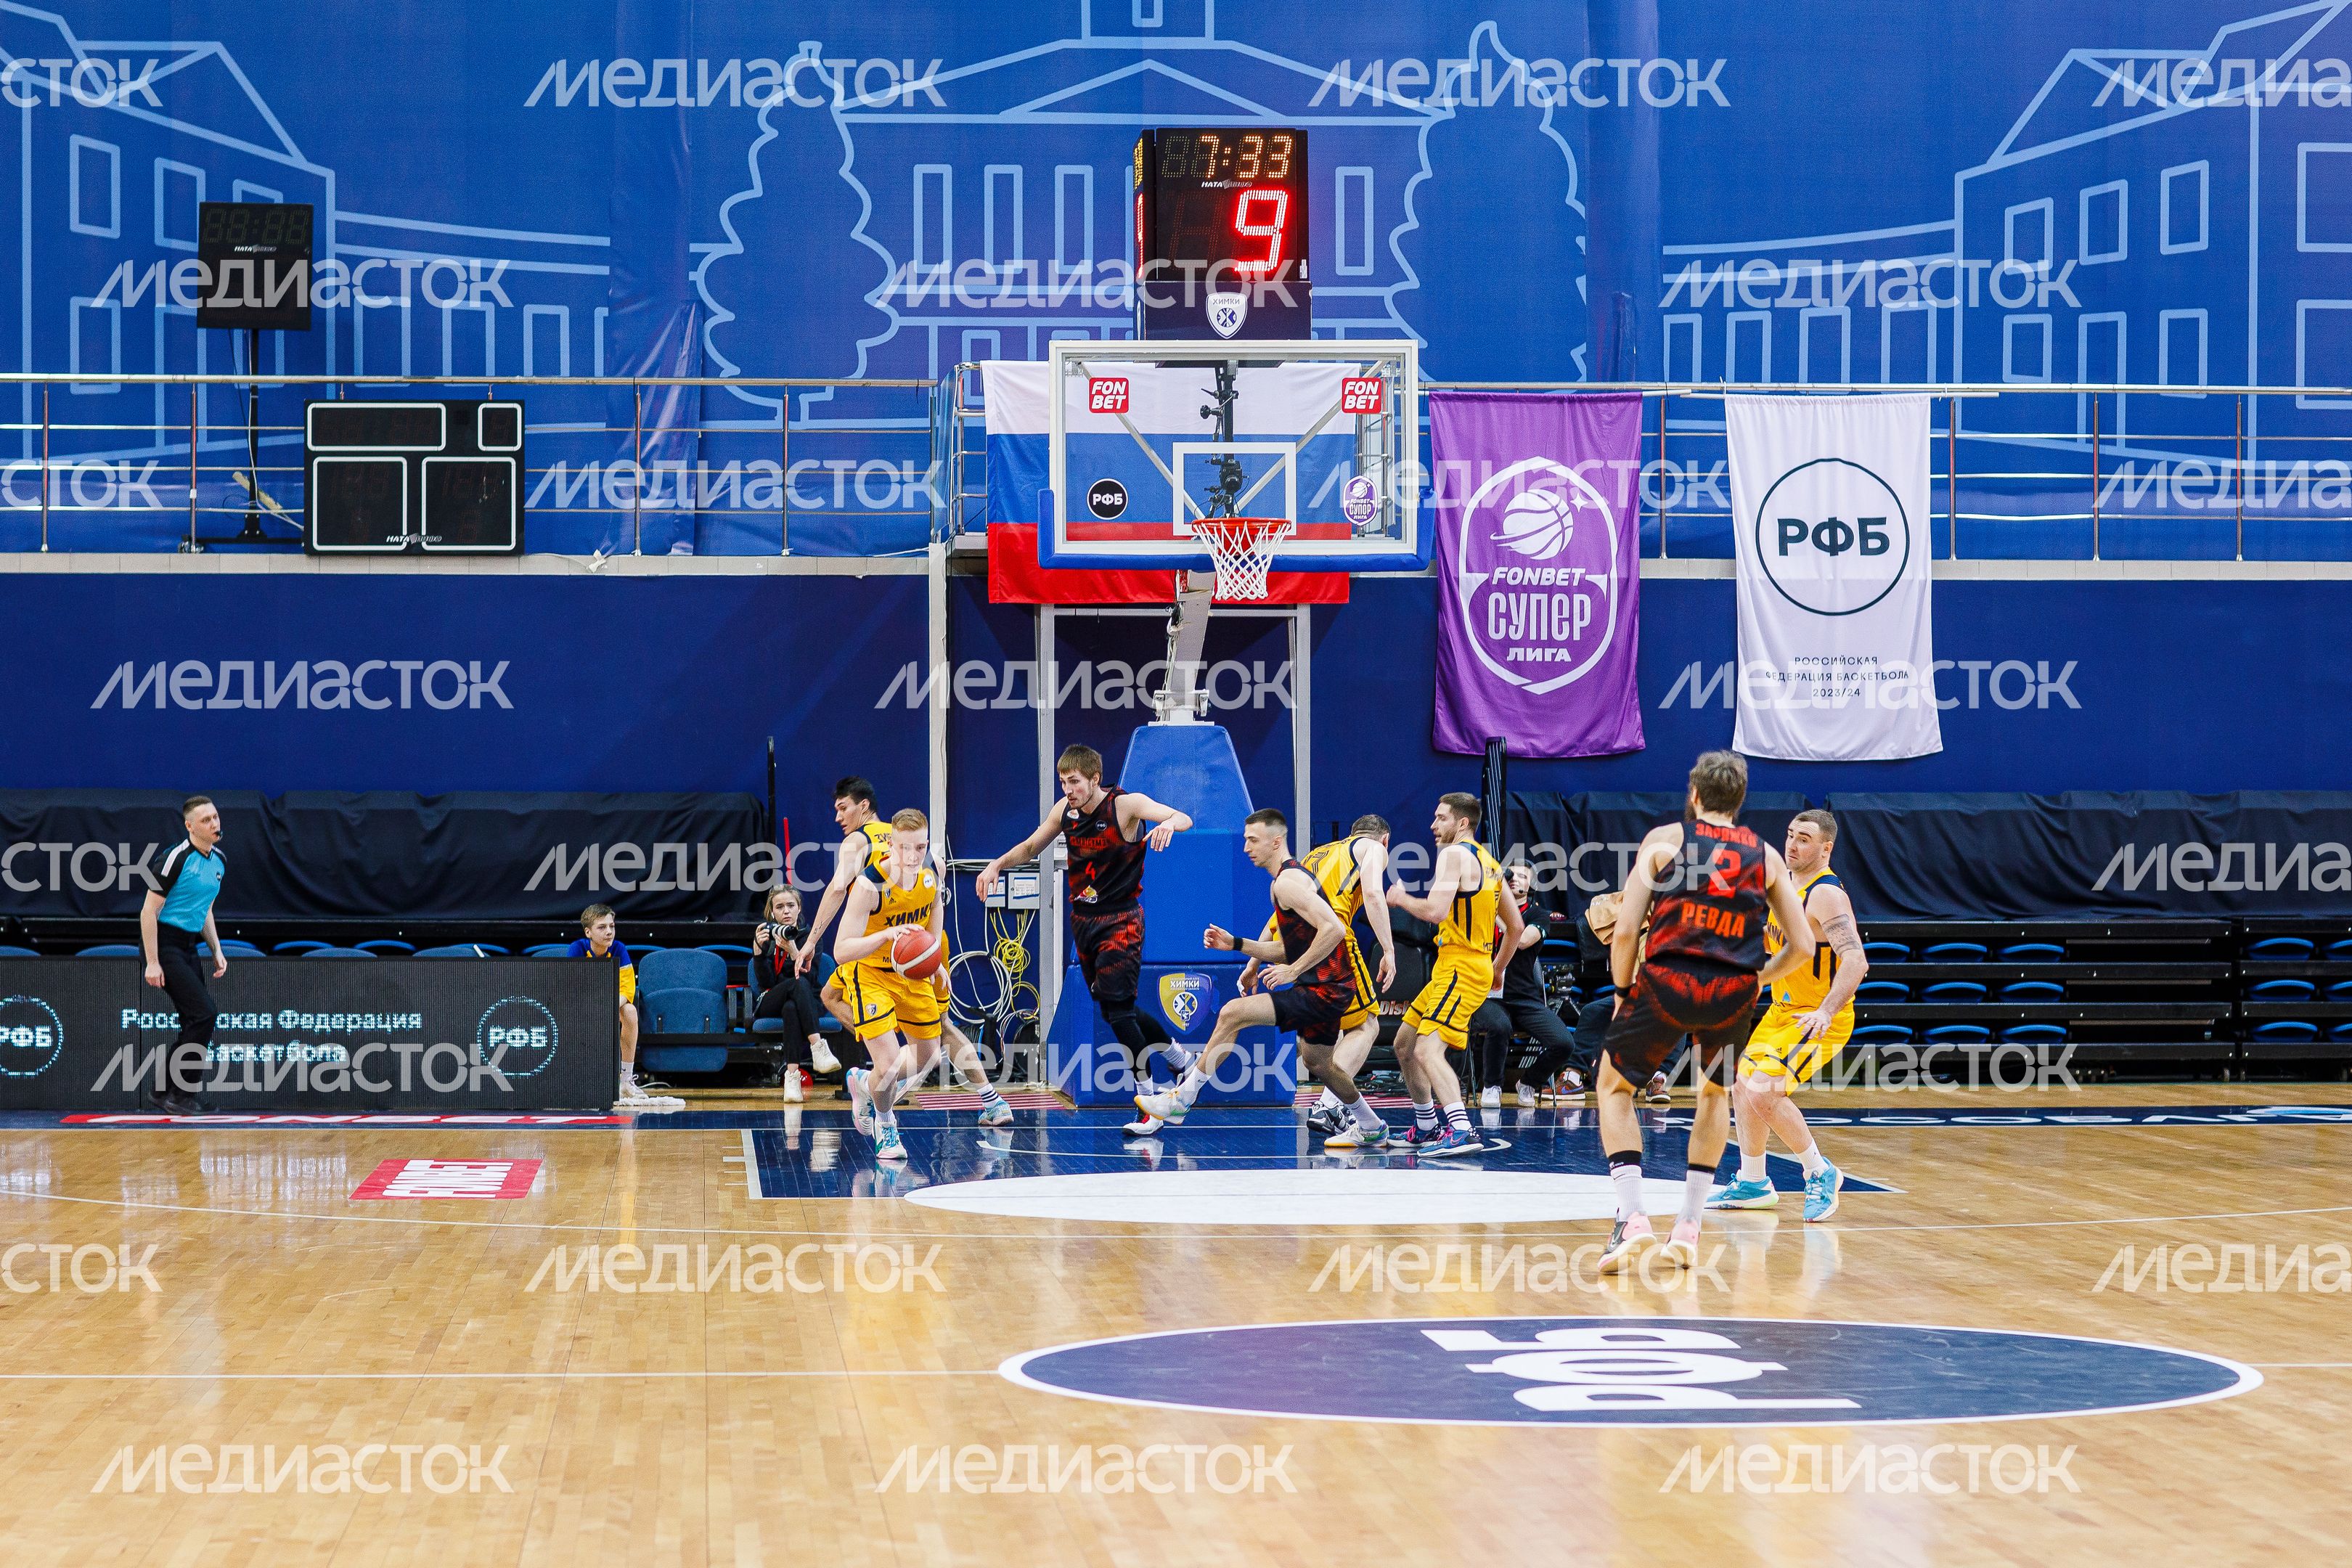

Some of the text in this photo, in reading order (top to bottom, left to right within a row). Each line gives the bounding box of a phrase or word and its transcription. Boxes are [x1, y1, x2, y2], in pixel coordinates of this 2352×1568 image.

[1236, 189, 1289, 271] 9
[1091, 381, 1127, 395] FON
[1344, 381, 1379, 395] FON
[1090, 396, 1127, 410] BET
[1343, 396, 1380, 410] BET
[1093, 492, 1124, 507] РФБ
[1777, 516, 1889, 557] РФБ
[1493, 567, 1586, 587] FONBET
[1506, 648, 1572, 663] ЛИГА
[1794, 655, 1878, 666] РОССИЙСКАЯ
[1765, 670, 1909, 682] ФЕДЕРАЦИЯ БАСКЕТБОЛА
[1813, 688, 1861, 698] 2023/24
[1085, 862, 1096, 880] 4
[1707, 848, 1741, 899] 2
[1681, 902, 1746, 939] РЕВДА
[121, 1008, 422, 1034] Россская Федерация
[489, 1025, 547, 1048] РФБ
[88, 1114, 605, 1123] FONBET
[382, 1159, 513, 1198] FONBET
[1420, 1327, 1863, 1412] РФБ
